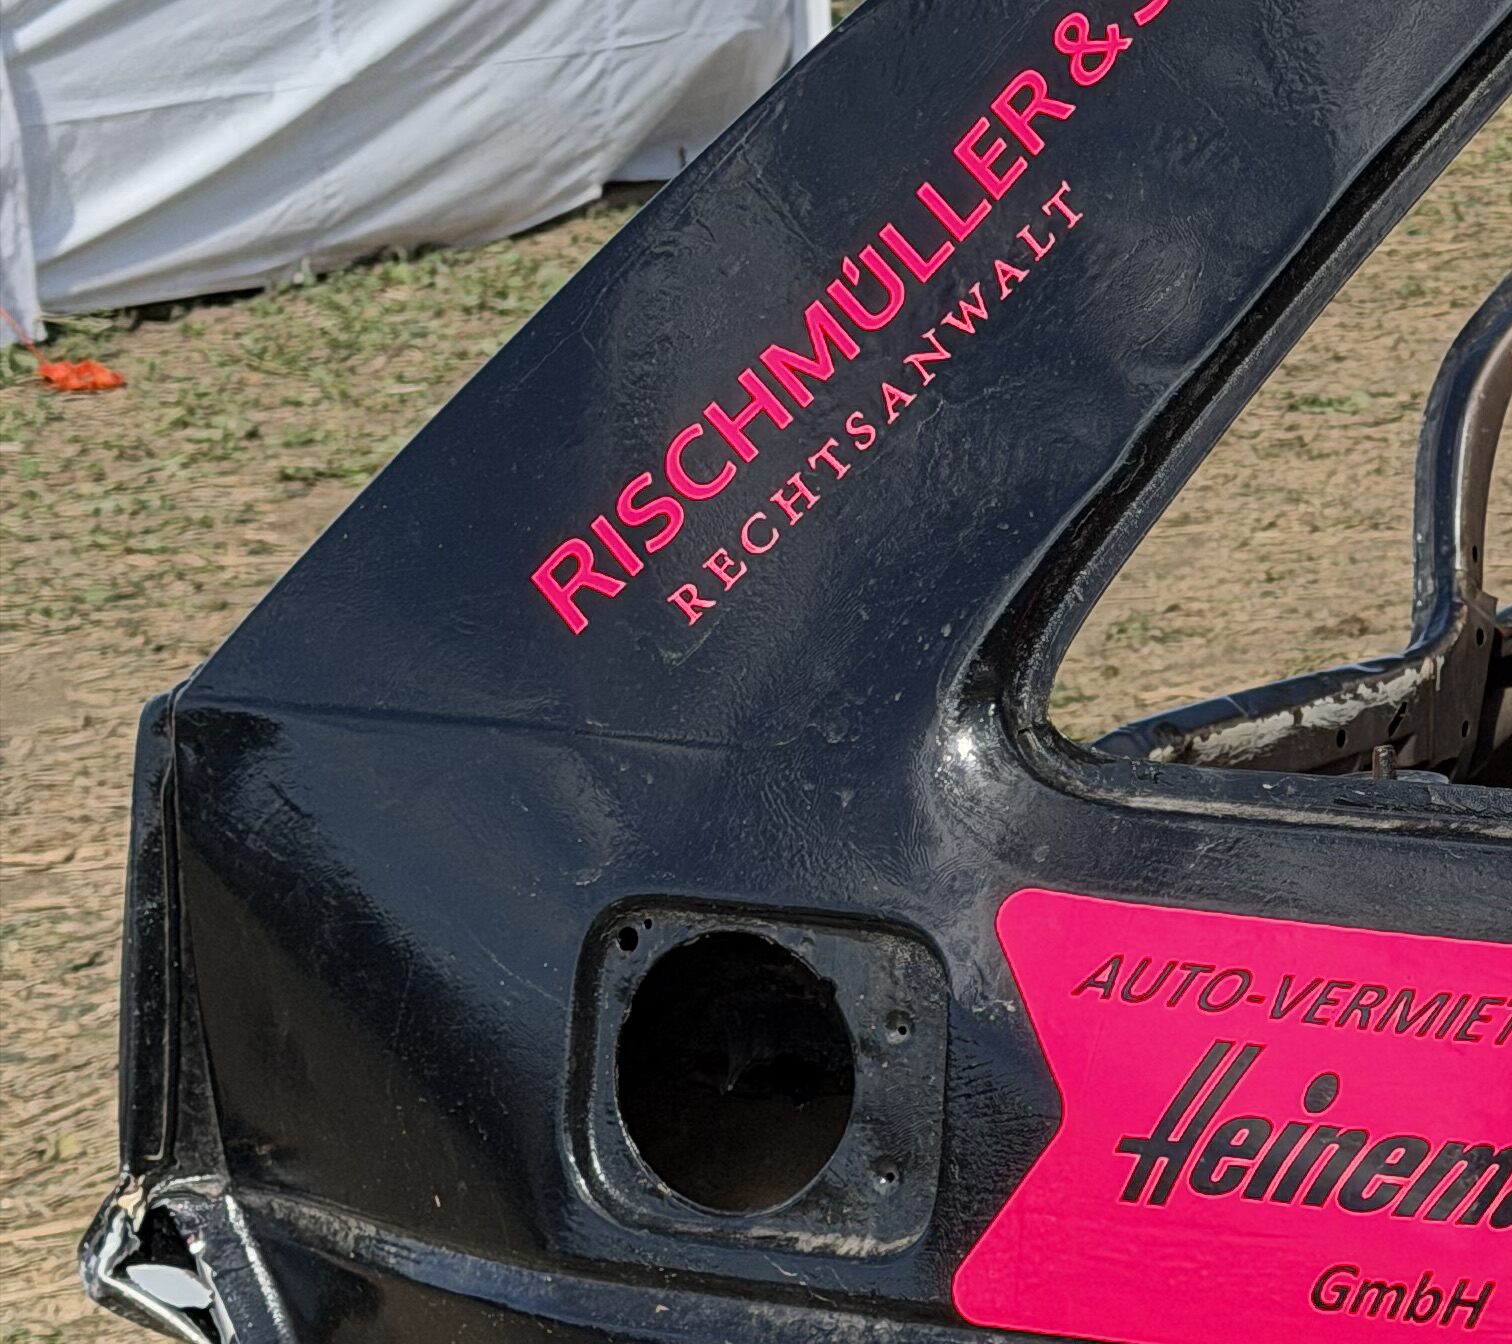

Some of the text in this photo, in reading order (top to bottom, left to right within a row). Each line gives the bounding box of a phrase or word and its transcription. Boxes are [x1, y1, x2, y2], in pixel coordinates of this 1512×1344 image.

[1053, 11, 1133, 88] &
[666, 180, 1086, 626] RECHTSANWALT
[1309, 1263, 1497, 1332] GmbH
